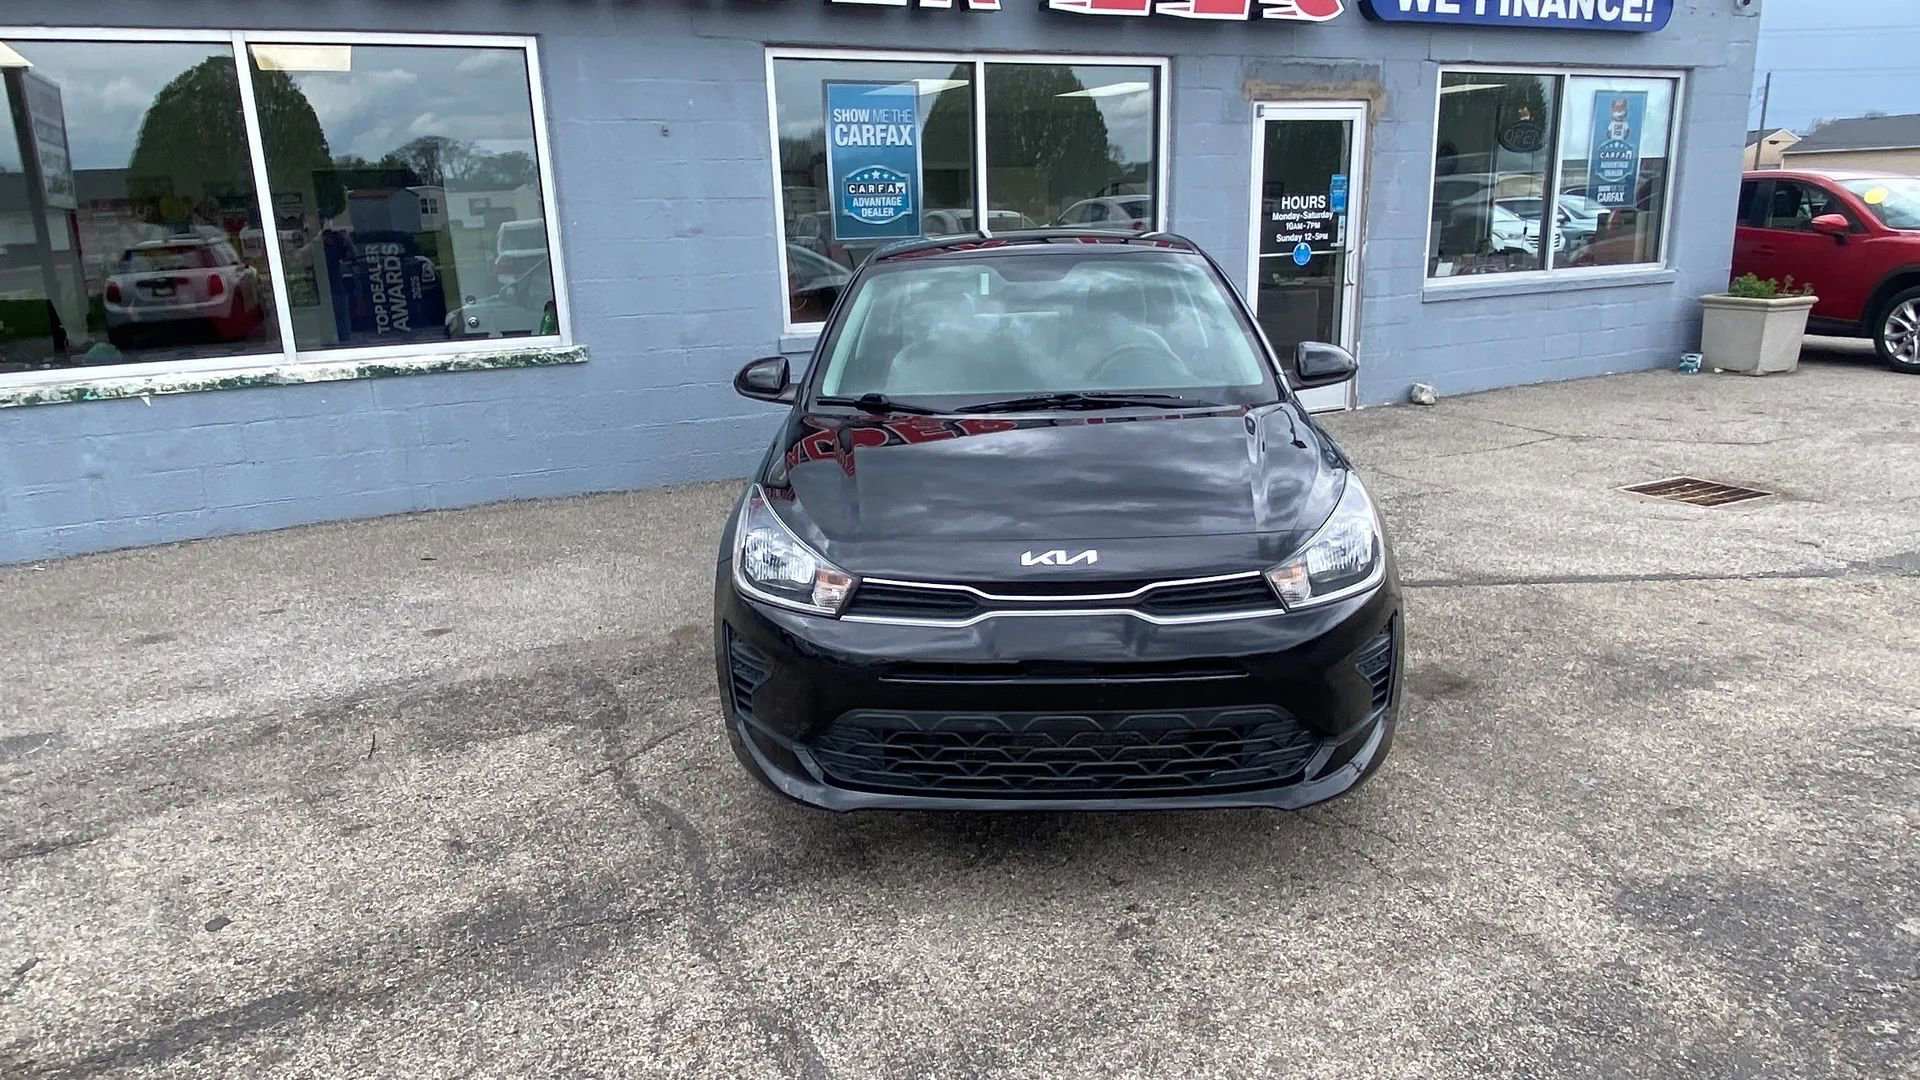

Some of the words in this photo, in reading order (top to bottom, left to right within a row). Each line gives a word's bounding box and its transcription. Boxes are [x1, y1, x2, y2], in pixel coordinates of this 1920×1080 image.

[833, 108, 869, 123] SHOW
[872, 109, 889, 123] ME
[892, 109, 913, 123] THE
[834, 124, 914, 147] CARFAX
[848, 183, 906, 195] CARFAX
[852, 197, 903, 207] ADVANTAGE
[1281, 195, 1326, 210] HOURS
[1597, 192, 1625, 203] CARFAX
[861, 207, 894, 217] DEALER
[1272, 210, 1334, 221] Monday-Saturday
[1276, 233, 1303, 243] Sunday
[365, 244, 387, 303] DEALER
[381, 242, 411, 333] AWARDS
[374, 305, 391, 335] TOP
[1021, 549, 1098, 566] KIA
